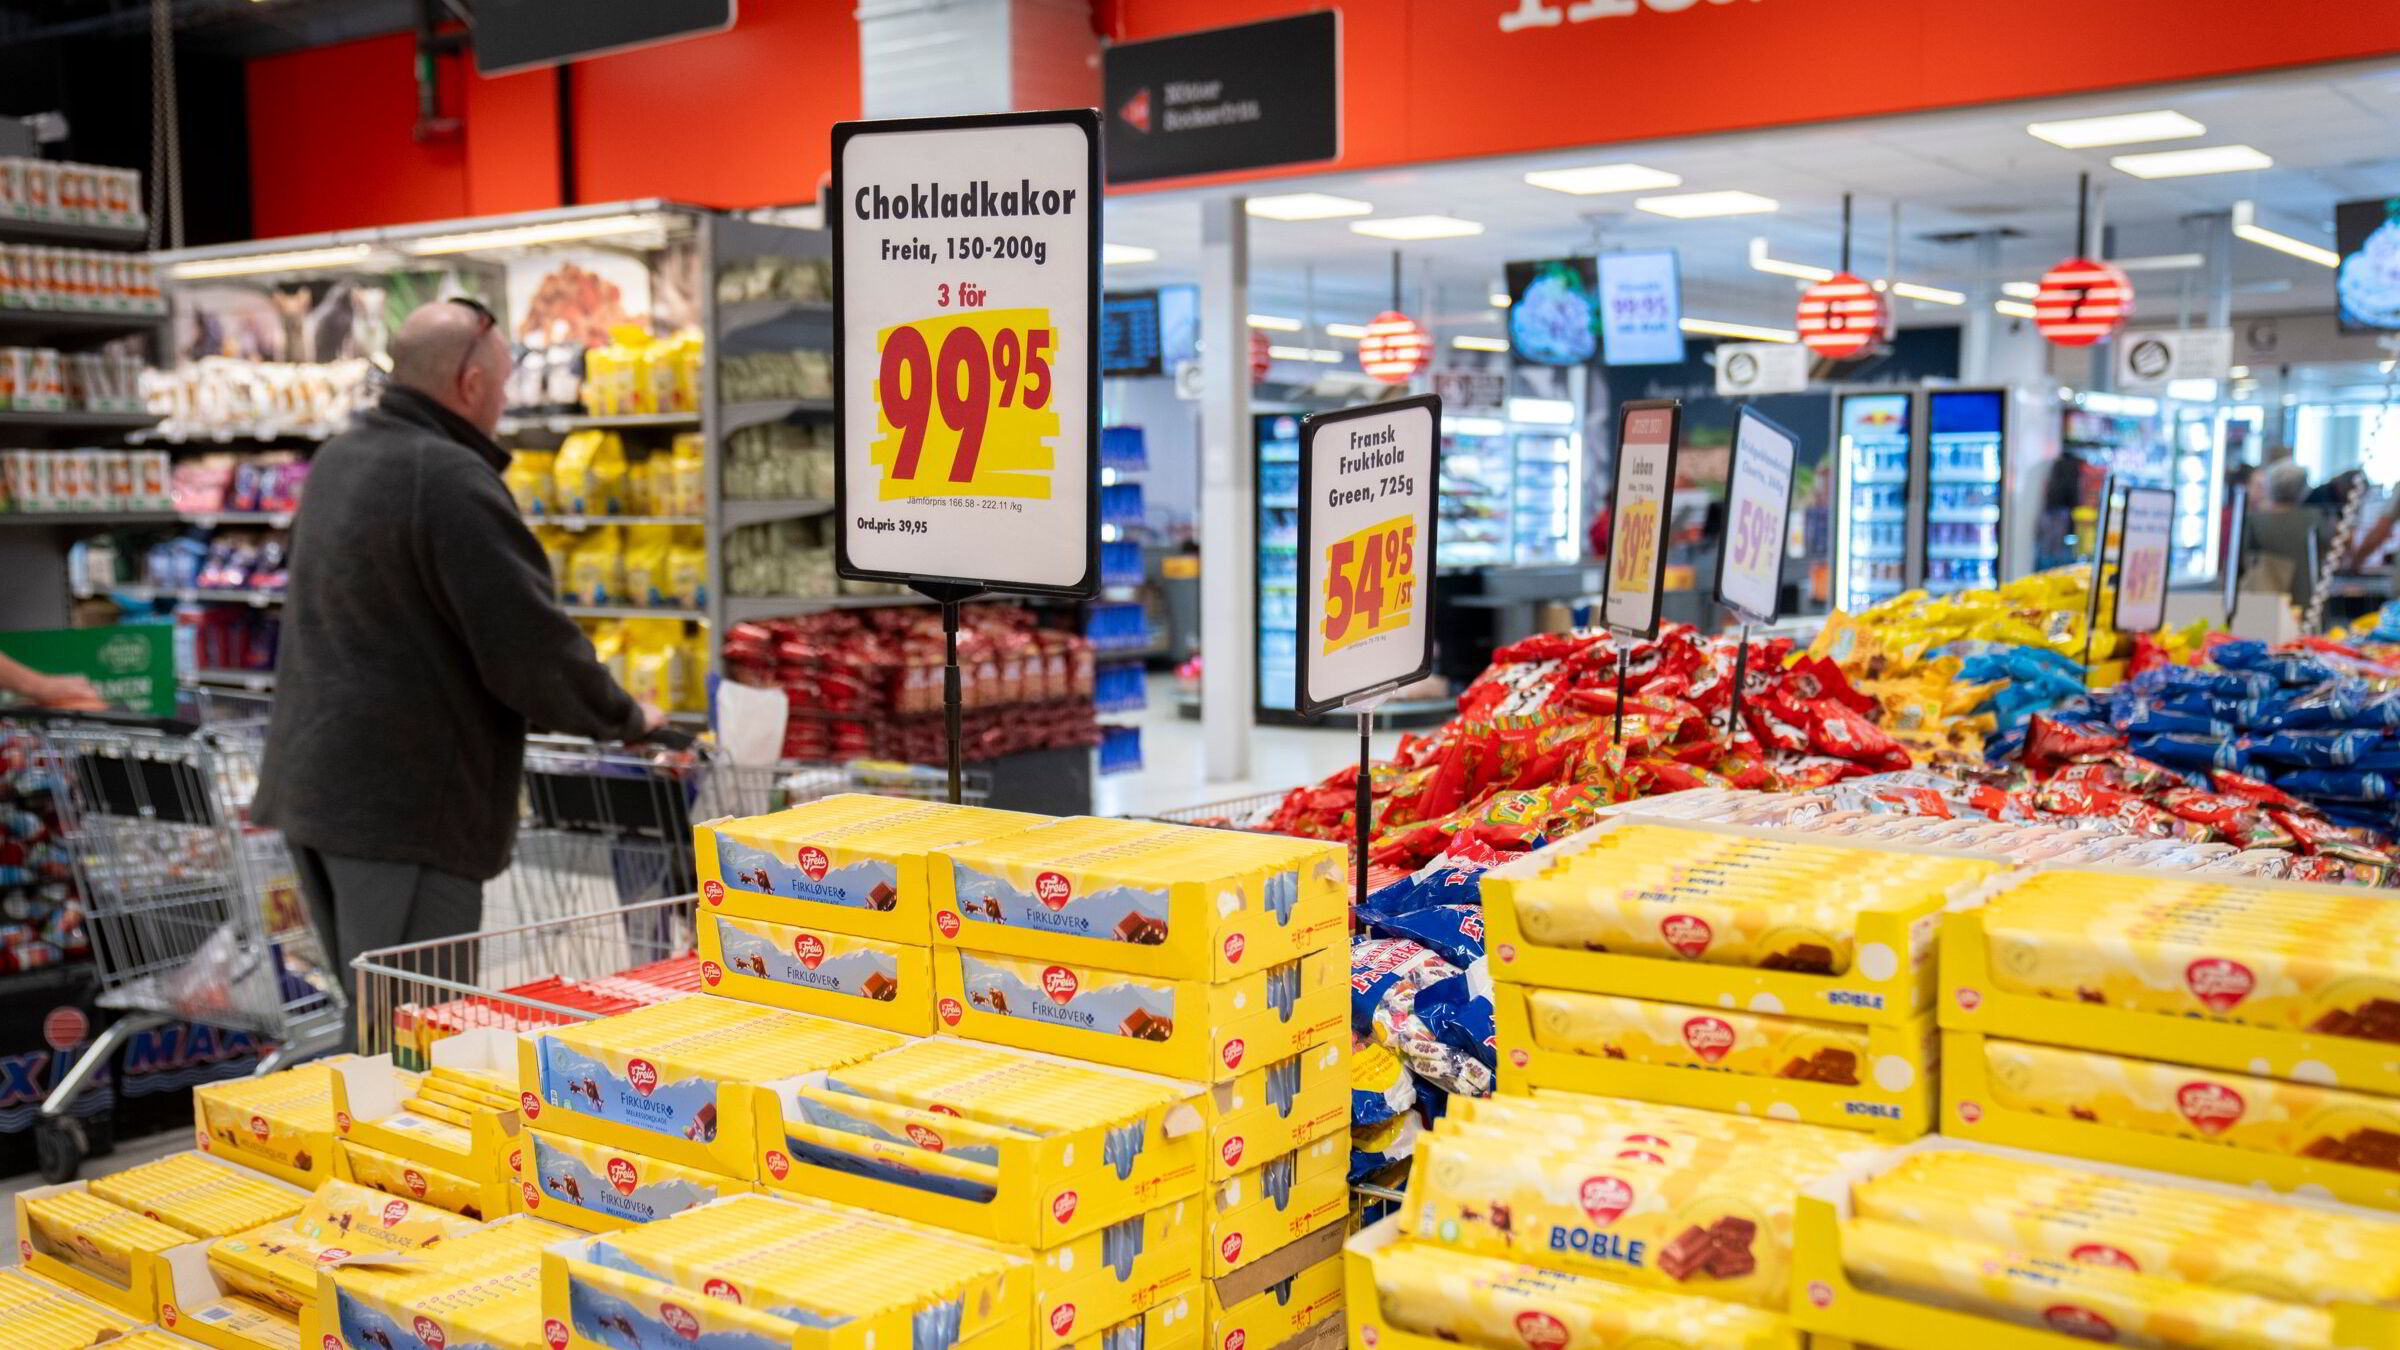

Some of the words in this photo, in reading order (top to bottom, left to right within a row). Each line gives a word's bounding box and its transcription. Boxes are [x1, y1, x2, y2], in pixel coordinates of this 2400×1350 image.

[855, 179, 1076, 220] Chokladkakor
[881, 237, 938, 264] Freia,
[947, 236, 1047, 265] 150-200g
[937, 283, 950, 307] 3
[959, 282, 986, 307] för
[2062, 285, 2092, 323] 7
[1825, 300, 1845, 331] 6
[1351, 424, 1395, 450] Fransk
[1340, 446, 1404, 475] Fruktkola
[1329, 486, 1375, 508] Green,
[1380, 474, 1413, 496] 725g
[907, 496, 946, 507] Jämförpris
[949, 498, 975, 509] 166.58
[981, 499, 1008, 511] 222.11
[1009, 501, 1022, 513] /kg
[857, 517, 896, 534] Ord.pris
[898, 520, 928, 535] 39,95
[802, 850, 827, 870] Freia
[705, 883, 723, 898] Freia
[792, 879, 839, 898] FIRKLØVER
[1040, 875, 1068, 898] Freia
[939, 913, 959, 930] Freia
[1027, 908, 1081, 928] FIRKLØVER
[799, 937, 823, 958] Freia
[704, 963, 721, 979] Freia
[787, 966, 833, 985] FIRKLØVER
[1047, 969, 1075, 992] Freia
[941, 1001, 961, 1018] Freia
[1827, 990, 1883, 1010] BOBLE
[1032, 1001, 1087, 1023] FIRKLØVER
[631, 1062, 655, 1085] Freia
[523, 1095, 540, 1111] Freia
[621, 1092, 667, 1114] FIRKLØVER
[1845, 1101, 1901, 1120] BOBLE
[911, 1127, 941, 1146] Freia
[768, 1153, 788, 1171] Freia
[612, 1162, 636, 1184] Freia
[524, 1185, 539, 1201] Freia
[600, 1190, 647, 1213] FIRKLØVER
[1551, 1227, 1646, 1267] BOBLE
[419, 1320, 442, 1342] Freia
[547, 1322, 567, 1342] Freia
